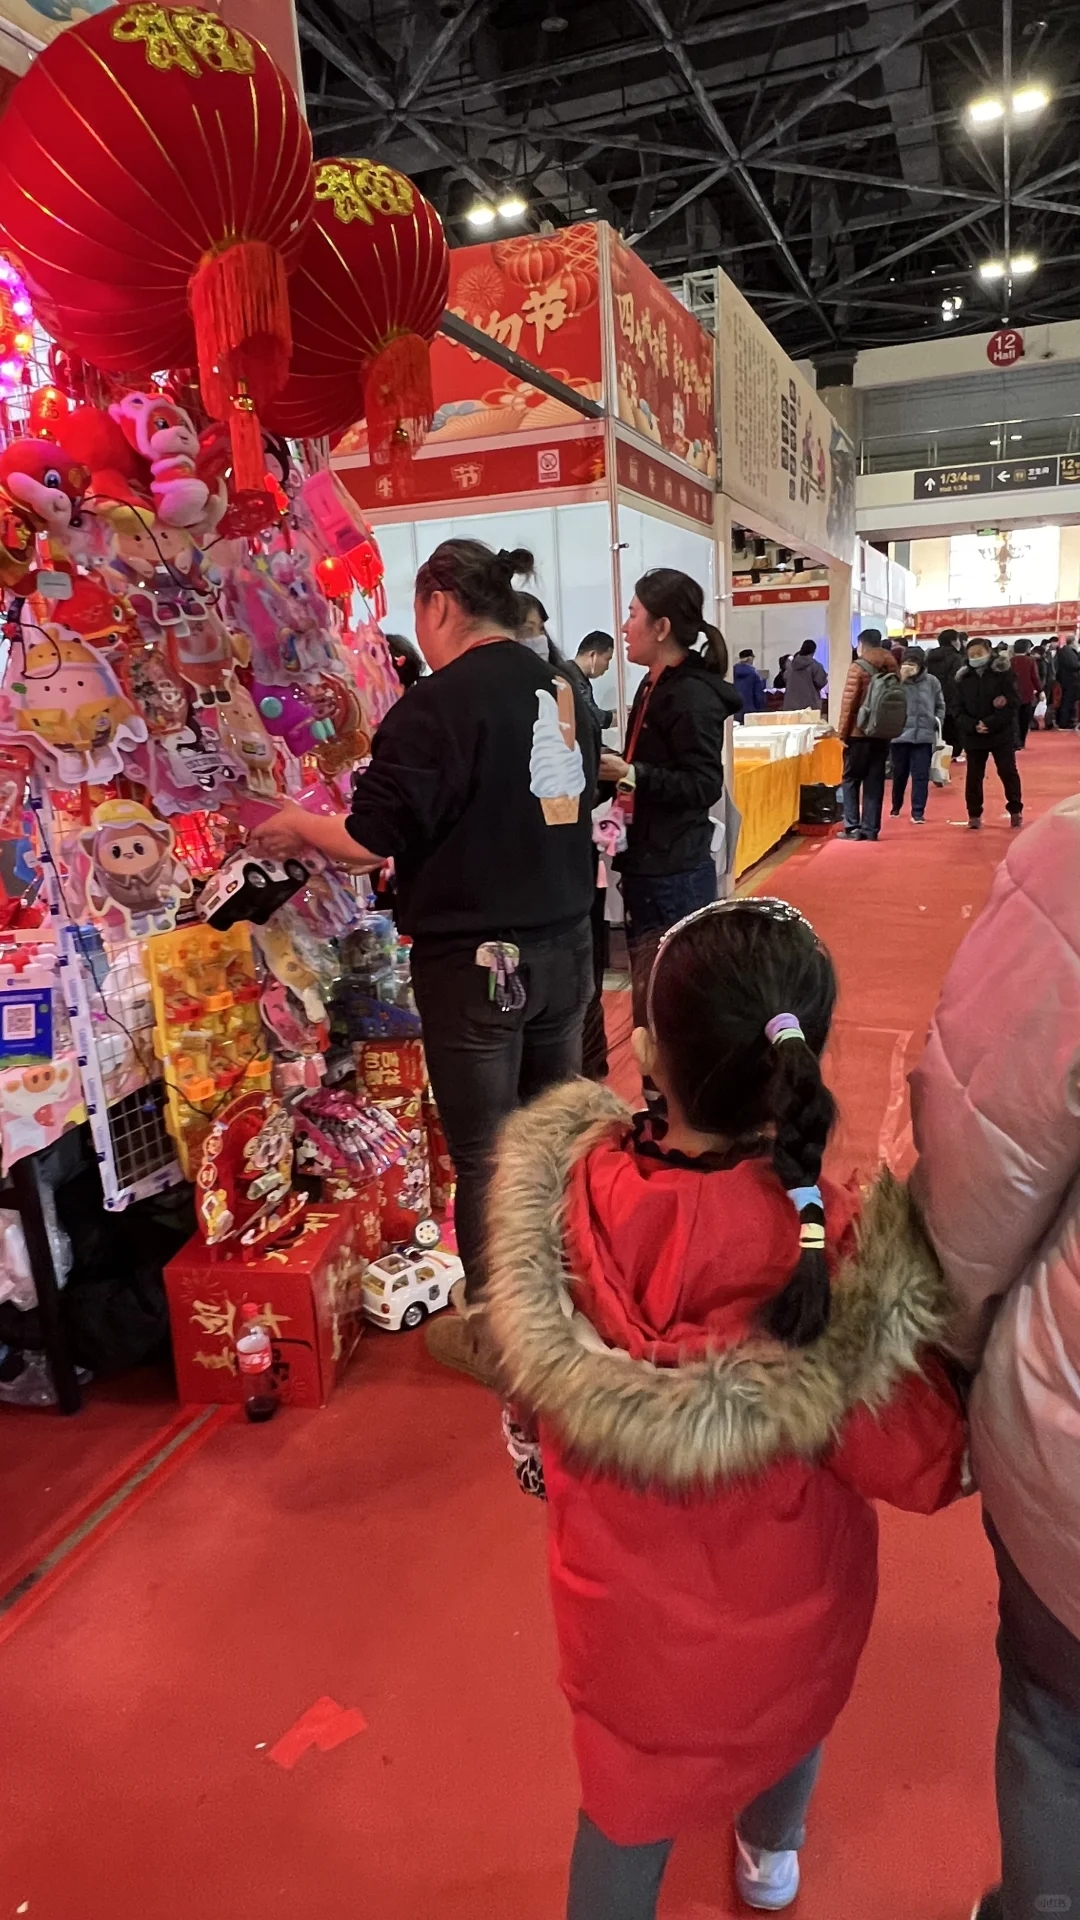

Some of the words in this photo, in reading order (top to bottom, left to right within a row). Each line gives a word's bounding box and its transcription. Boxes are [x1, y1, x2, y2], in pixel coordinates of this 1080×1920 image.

[434, 283, 568, 361] 物节
[995, 334, 1016, 349] 12
[994, 350, 1016, 360] Hall
